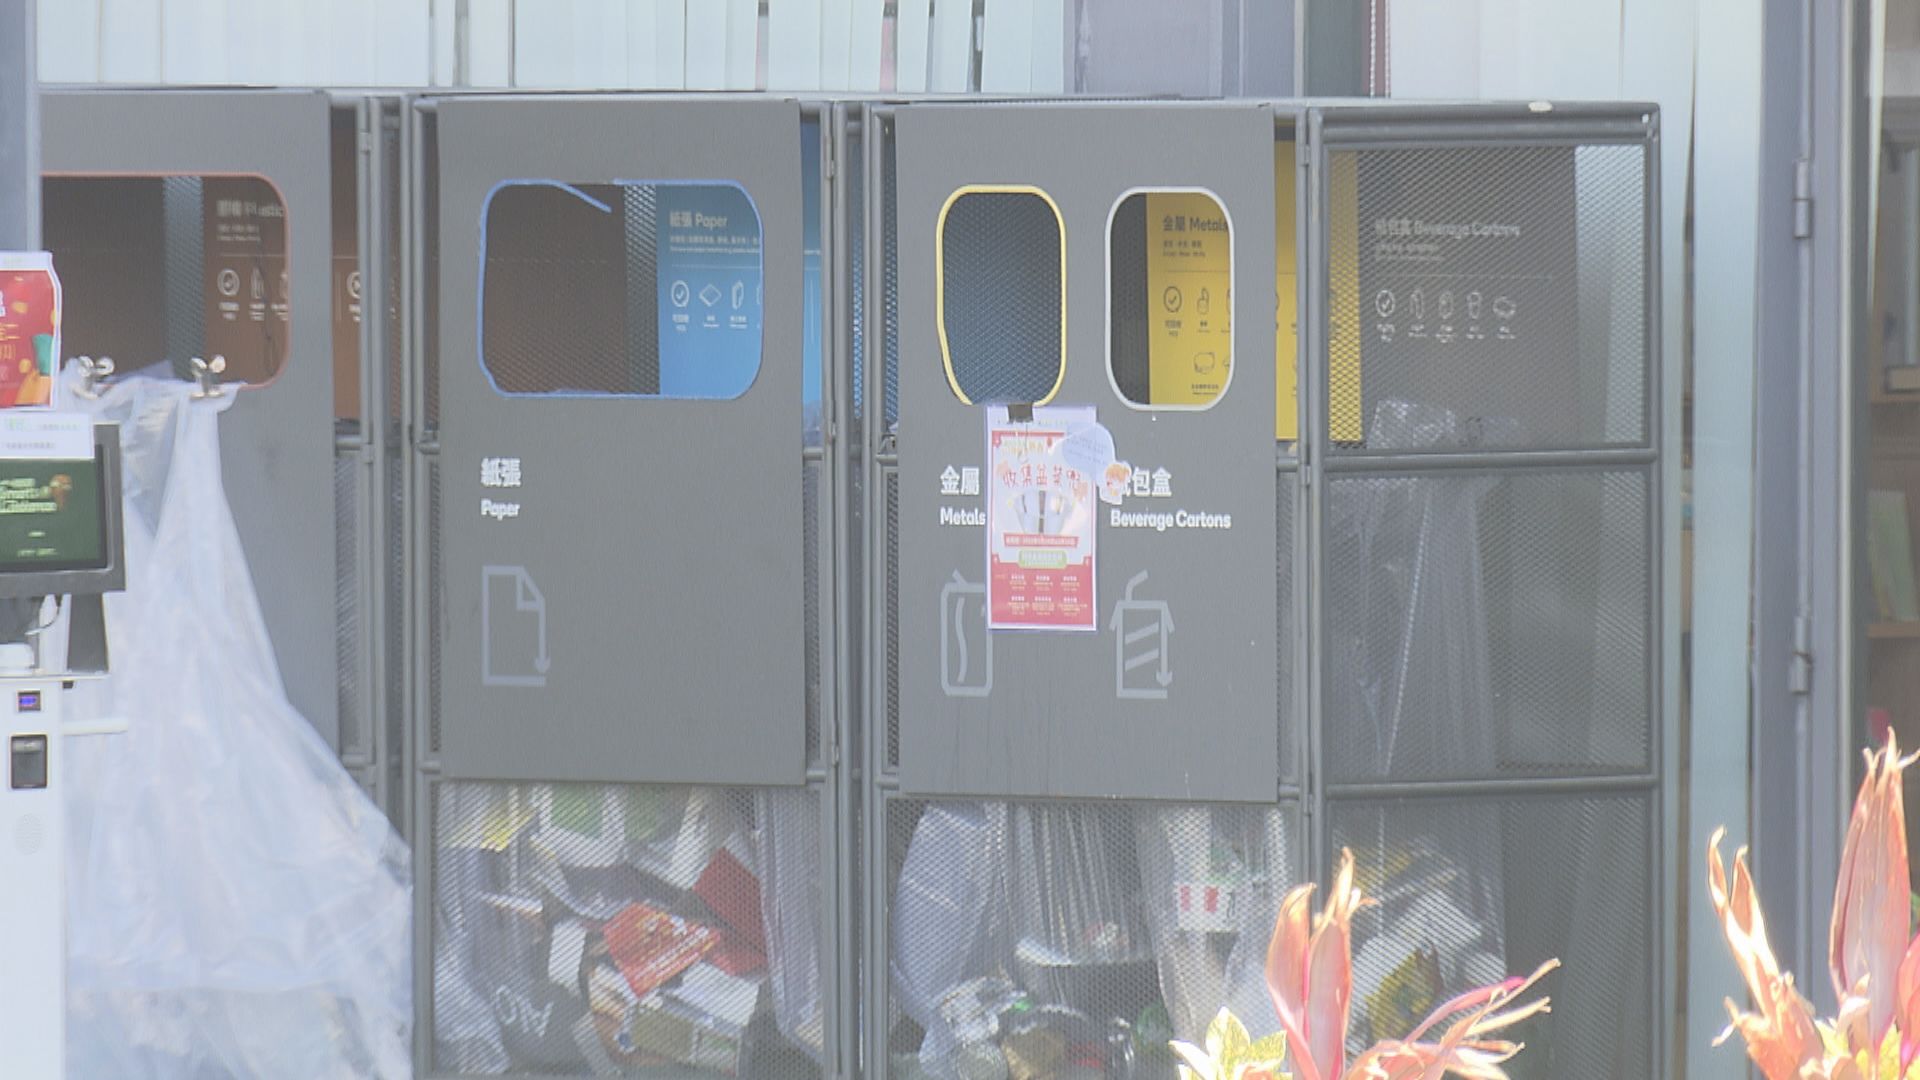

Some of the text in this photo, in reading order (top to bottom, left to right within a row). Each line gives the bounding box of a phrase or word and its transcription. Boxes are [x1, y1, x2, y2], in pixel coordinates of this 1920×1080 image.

[695, 212, 728, 231] Paper
[1414, 219, 1470, 239] Beverage
[480, 457, 522, 488] 紙張
[939, 464, 980, 496] 金屬
[1125, 466, 1173, 497] 包盒
[480, 498, 521, 521] Paper
[939, 507, 986, 525] Metals
[1110, 508, 1232, 531] Beverage Cartons
